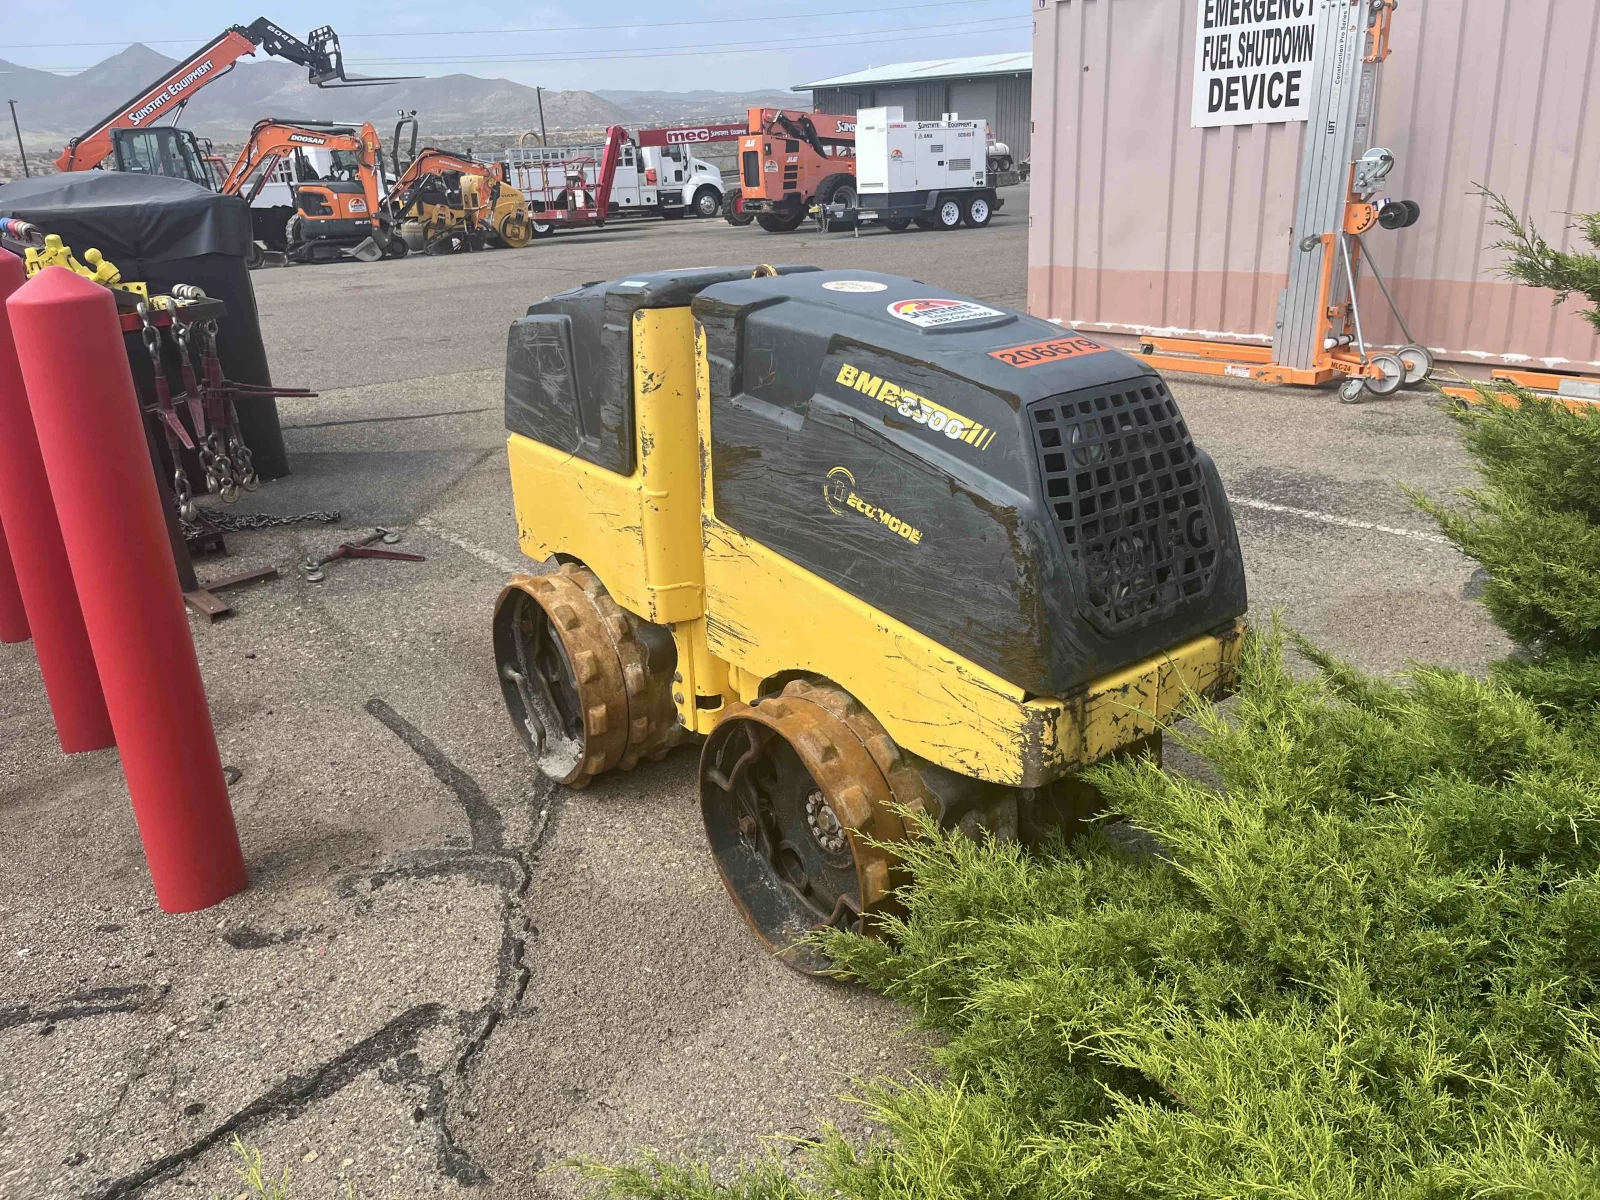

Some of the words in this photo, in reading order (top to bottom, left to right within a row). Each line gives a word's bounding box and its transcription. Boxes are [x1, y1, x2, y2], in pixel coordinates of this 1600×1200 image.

[266, 25, 296, 46] 6042
[1202, 34, 1234, 72] FUEL
[1237, 24, 1315, 68] SHUTDOWN
[1335, 44, 1344, 85] Construction
[128, 91, 171, 126] SUNSTATE
[166, 59, 214, 97] EQUIPMENT
[1207, 70, 1302, 113] DEVICE
[667, 130, 709, 143] mec
[917, 122, 940, 130] SUNSTATE
[947, 121, 972, 129] EQUIPMENT
[290, 134, 325, 145] DOOSAN
[1000, 338, 1101, 365] 206679
[1331, 361, 1352, 372] MLC-24
